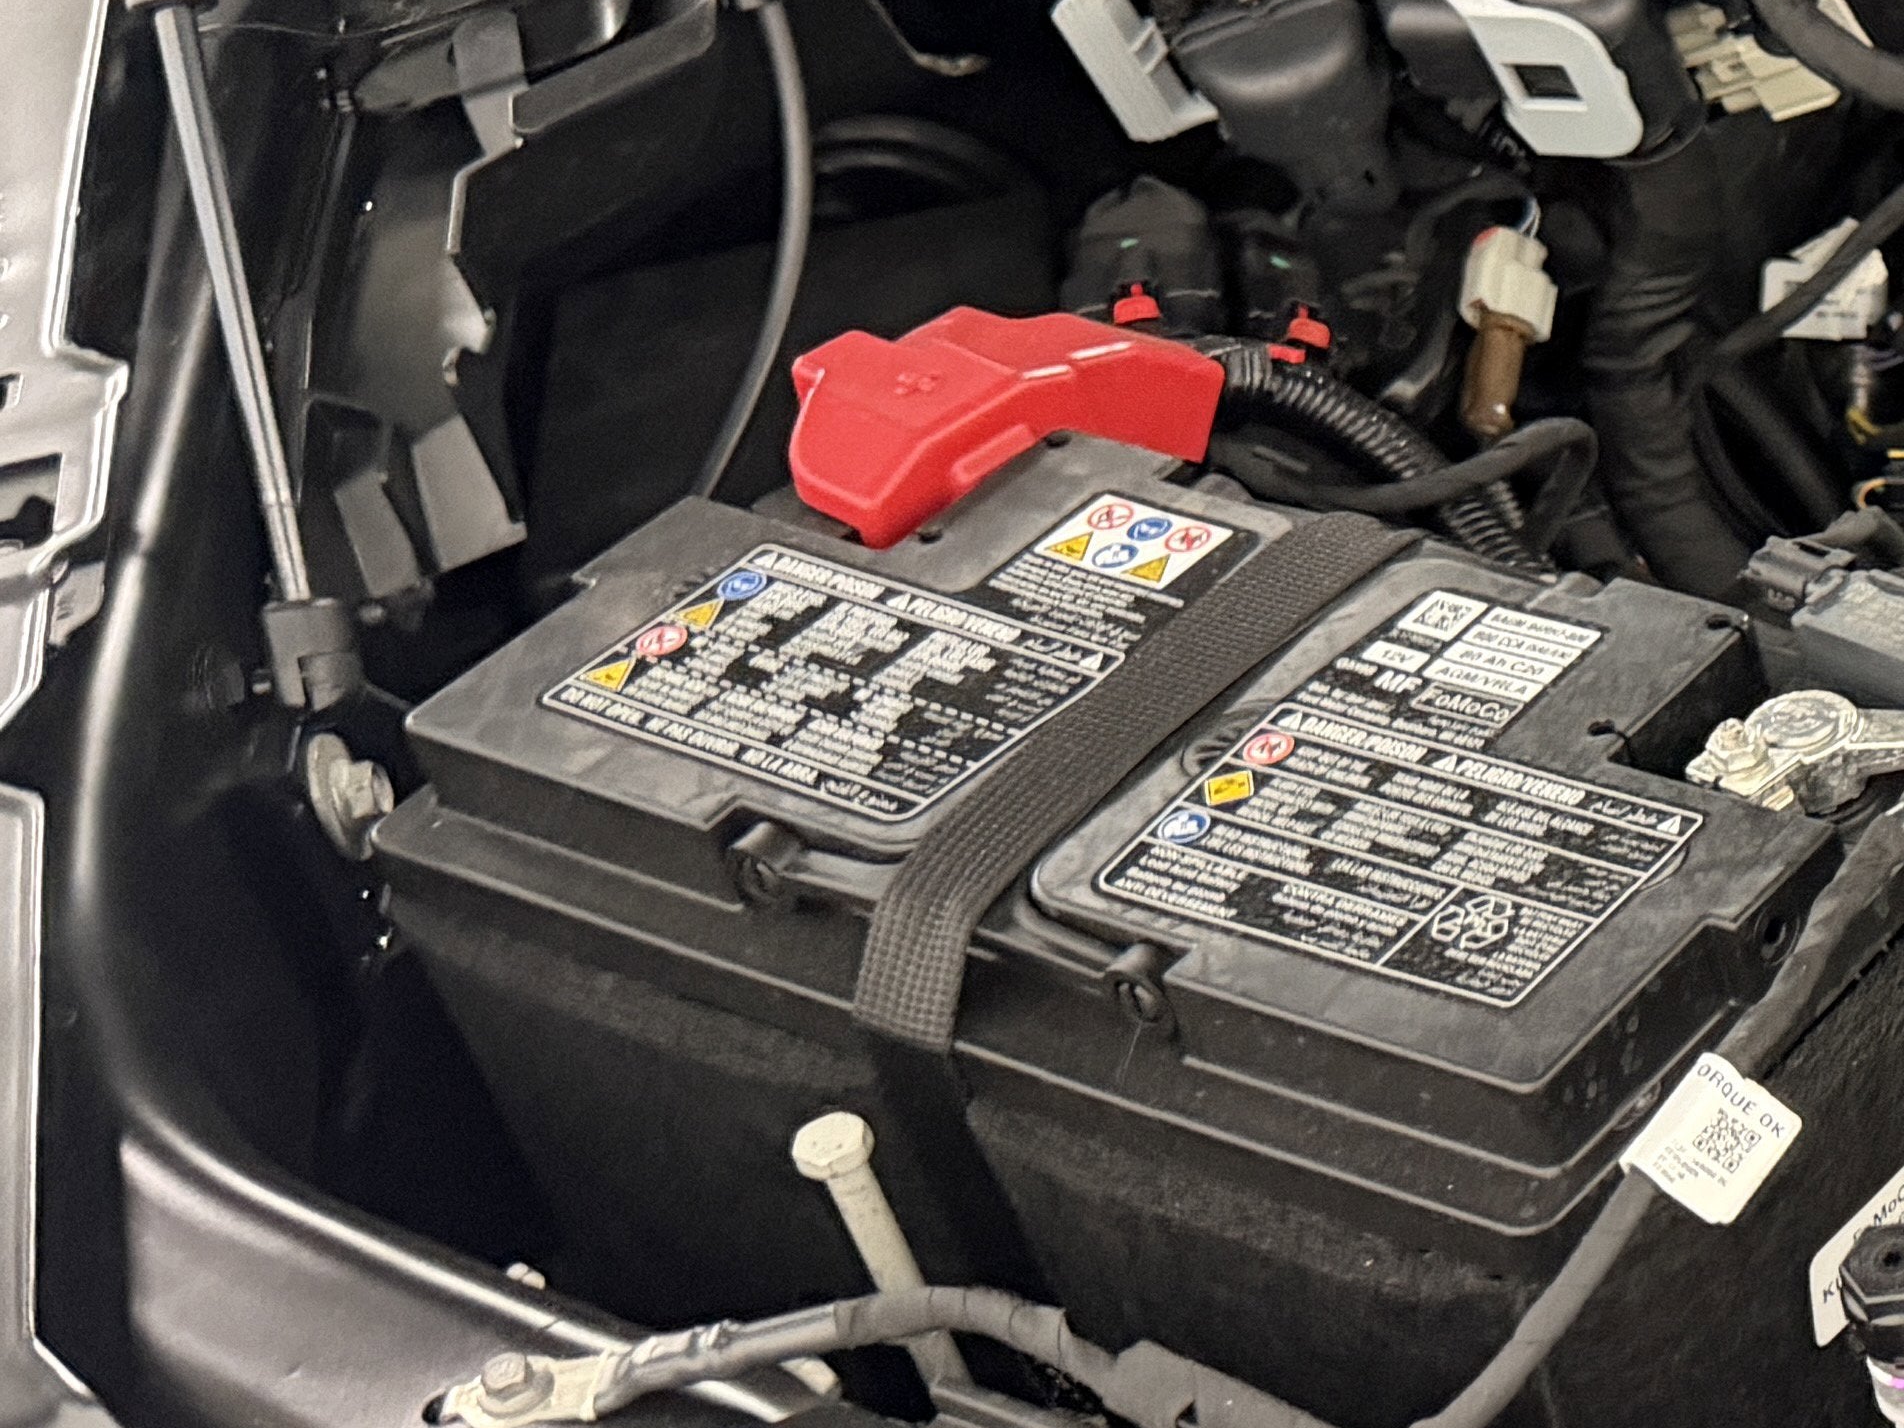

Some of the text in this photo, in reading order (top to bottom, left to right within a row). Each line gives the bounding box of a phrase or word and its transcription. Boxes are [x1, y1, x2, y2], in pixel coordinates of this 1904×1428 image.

[1420, 684, 1512, 722] FoMoCo
[1696, 1063, 1786, 1139] ORQUE OK
